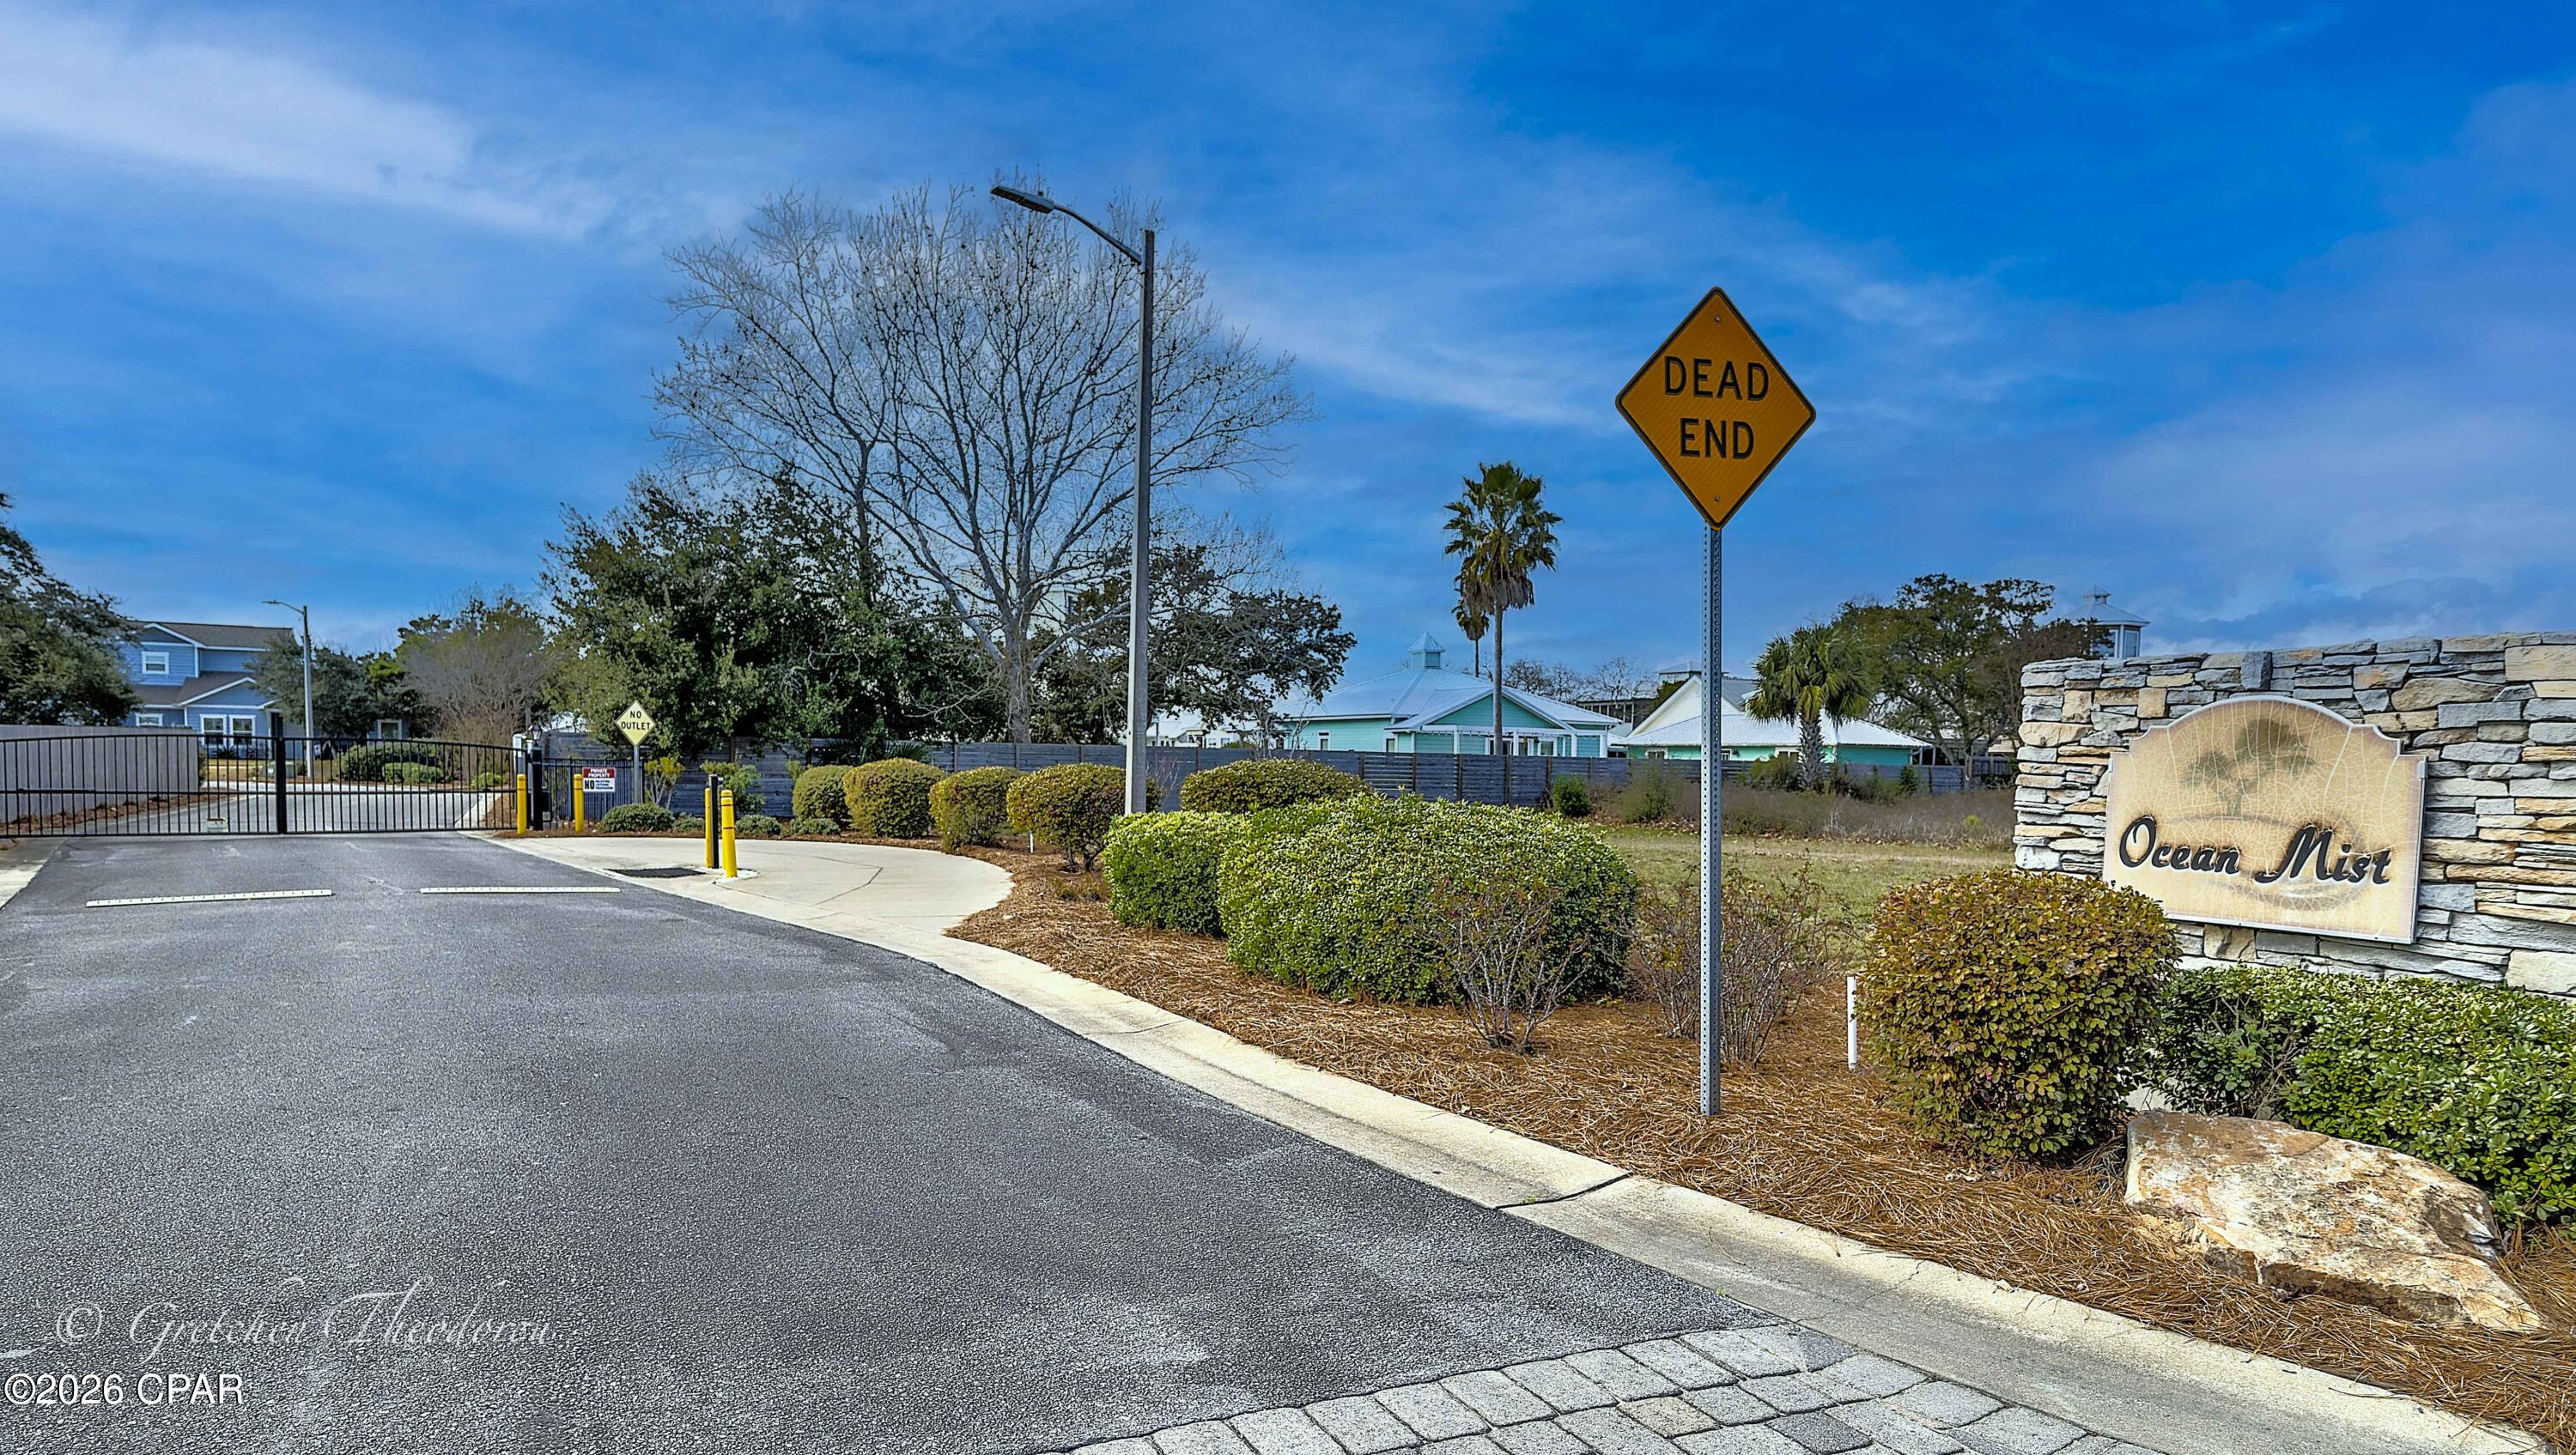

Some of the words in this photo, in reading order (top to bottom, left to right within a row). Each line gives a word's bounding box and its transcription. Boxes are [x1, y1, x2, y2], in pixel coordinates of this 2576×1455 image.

[1665, 356, 1769, 401] DEAD
[1680, 417, 1754, 459] END
[621, 721, 650, 730] OUTLET
[585, 779, 595, 790] NO
[2118, 815, 2242, 875] Ocean
[2254, 824, 2391, 885] Mist
